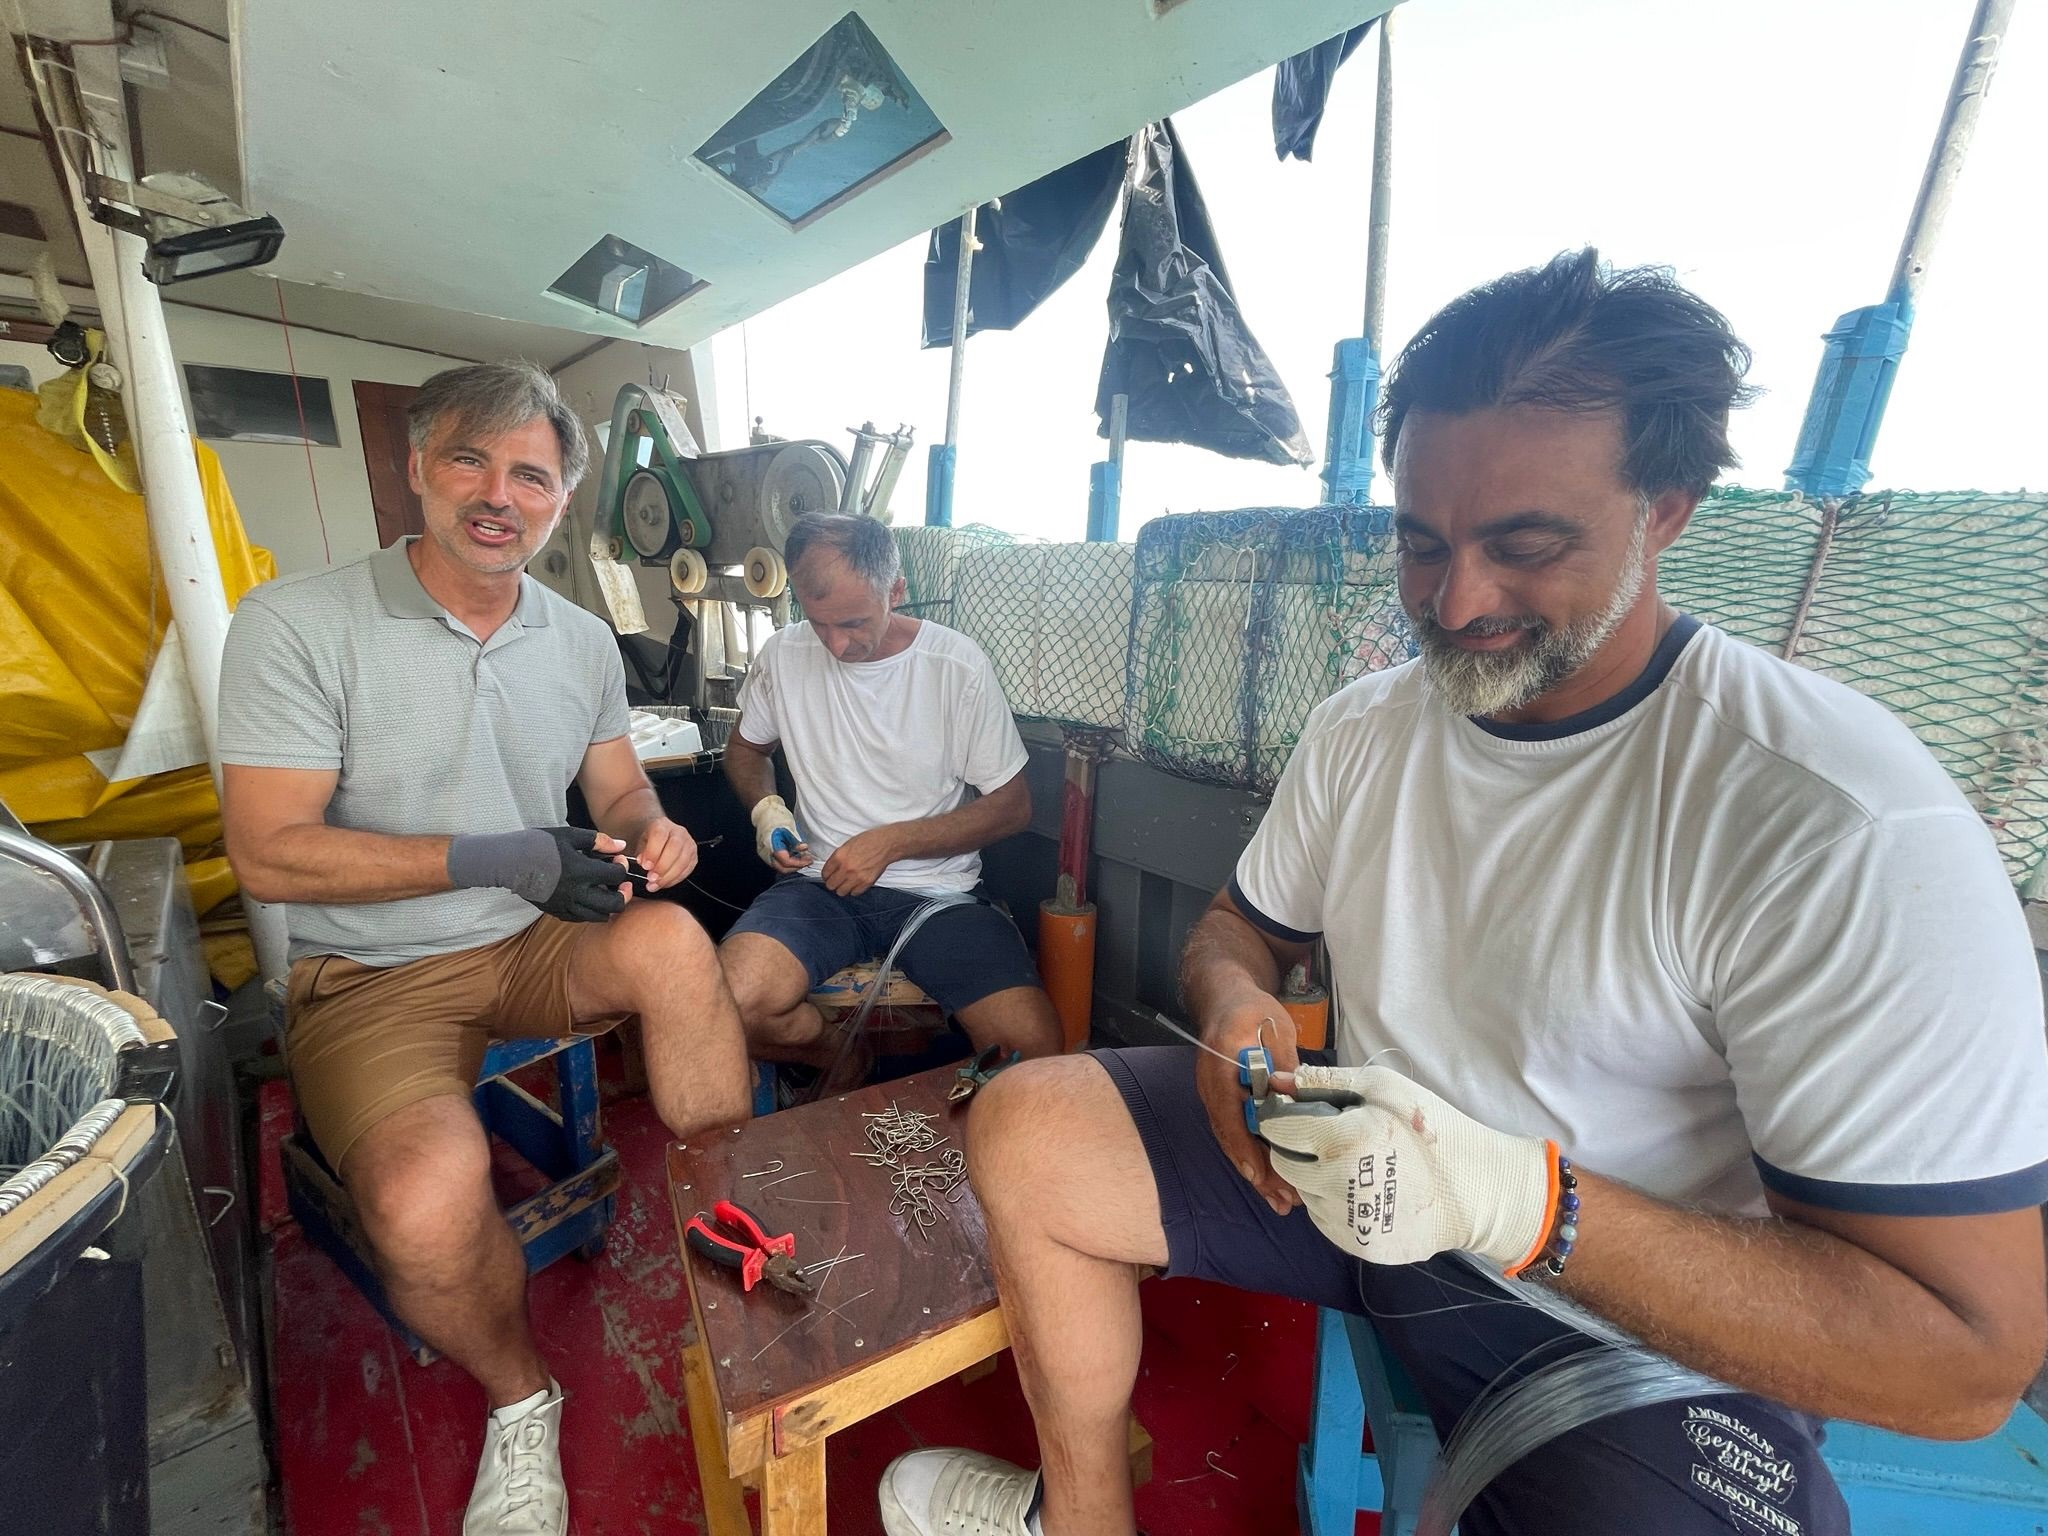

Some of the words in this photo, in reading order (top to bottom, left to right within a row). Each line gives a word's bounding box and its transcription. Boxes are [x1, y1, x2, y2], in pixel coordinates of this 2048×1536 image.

[1385, 1148, 1397, 1178] 9/L
[1687, 1405, 1775, 1456] AMERICAN
[1690, 1422, 1795, 1482] General
[1717, 1450, 1785, 1494] Ethyl
[1697, 1470, 1800, 1536] GASOLINE
